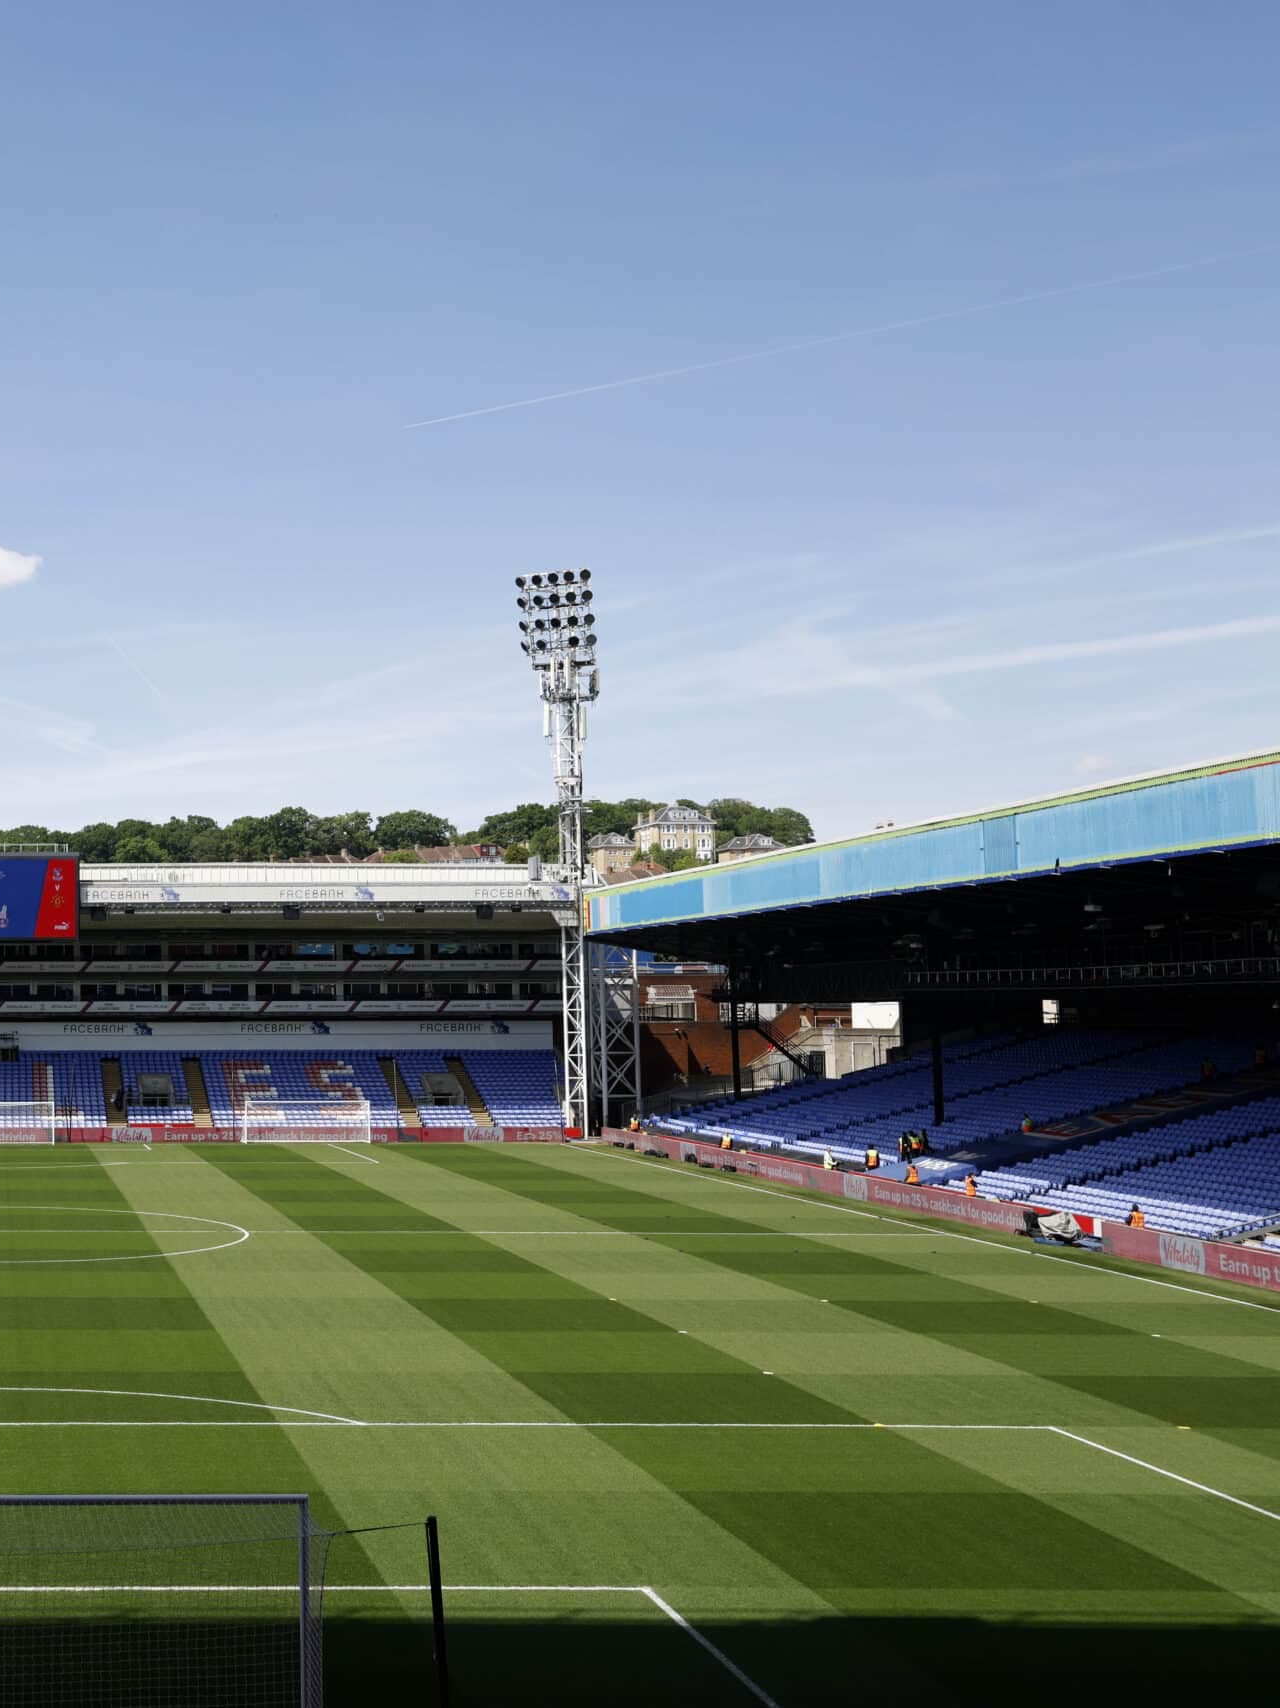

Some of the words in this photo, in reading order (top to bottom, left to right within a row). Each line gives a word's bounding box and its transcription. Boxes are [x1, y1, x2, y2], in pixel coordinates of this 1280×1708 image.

[279, 889, 345, 899] FACEBANK
[63, 1023, 124, 1033] FACEBANK
[240, 1023, 301, 1033] FACEBANK
[419, 1023, 481, 1033] FACEBANK
[164, 1131, 188, 1141] Earn
[191, 1132, 206, 1143] up
[208, 1131, 219, 1141] to
[874, 1185, 890, 1200] Earn
[891, 1190, 901, 1206] up
[902, 1191, 910, 1203] to
[911, 1193, 929, 1209] 25%
[930, 1197, 966, 1216] cashback
[967, 1202, 980, 1218] for
[981, 1210, 1004, 1225] good
[1219, 1253, 1249, 1276] Earn
[1252, 1263, 1271, 1285] up
